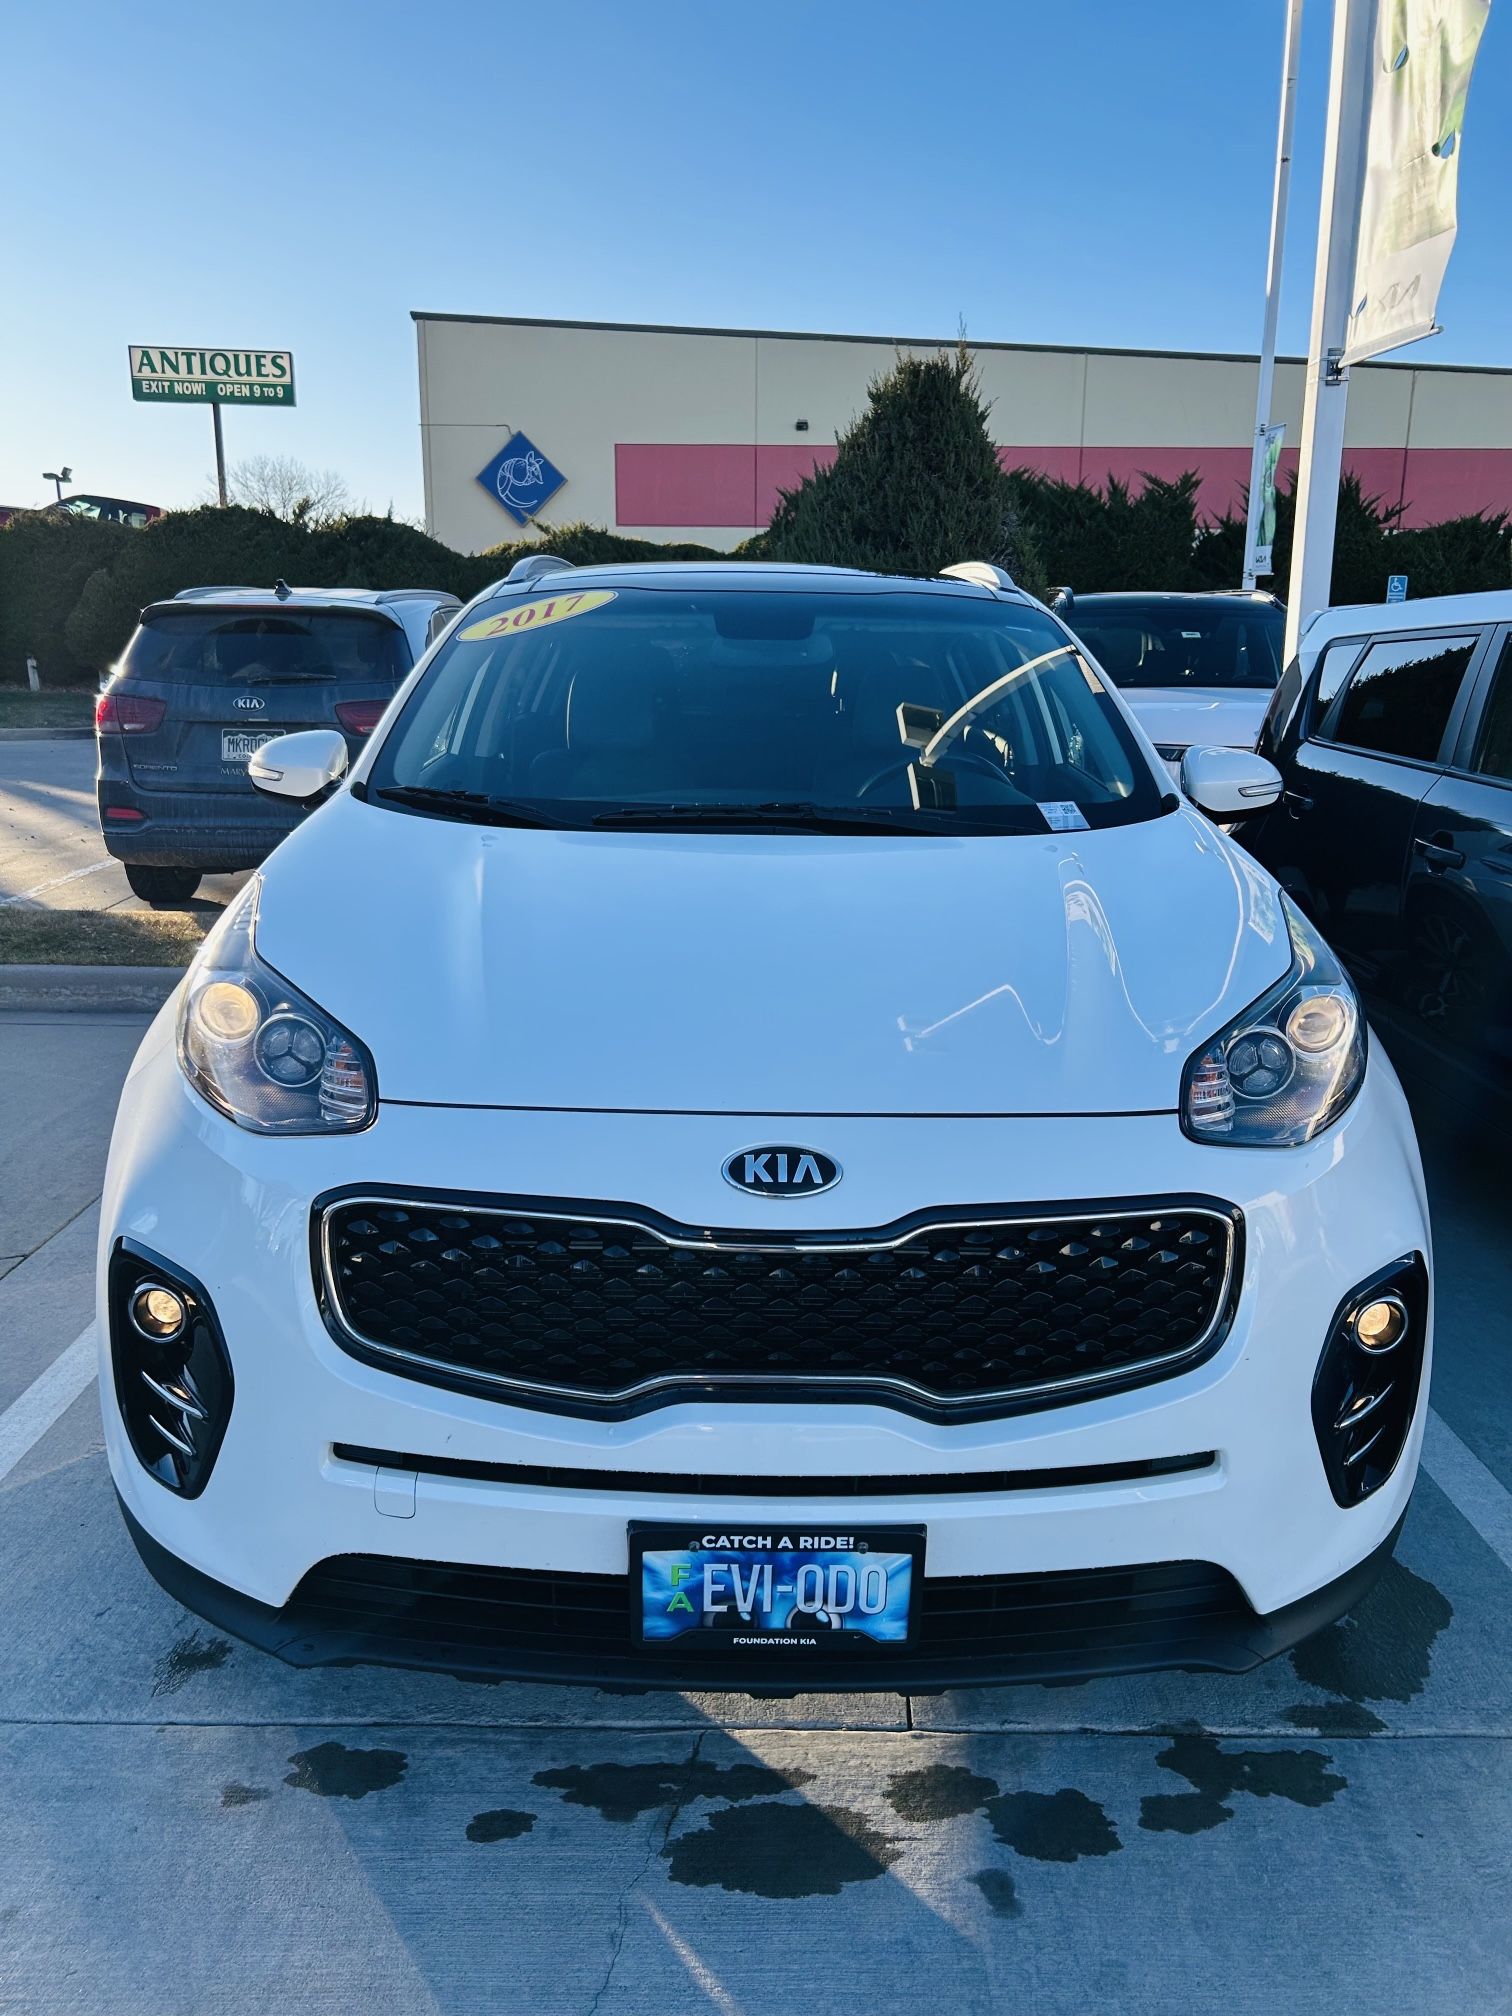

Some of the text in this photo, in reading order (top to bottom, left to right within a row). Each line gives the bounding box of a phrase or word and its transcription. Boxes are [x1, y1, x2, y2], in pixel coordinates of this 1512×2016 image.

[137, 350, 287, 379] ANTIQUES
[142, 380, 171, 394] EXIT
[174, 382, 206, 395] NOW!
[217, 384, 250, 397] OPEN
[253, 385, 261, 398] 9
[276, 386, 284, 398] 9
[486, 594, 586, 635] 2017
[237, 699, 260, 708] KIA
[744, 1153, 823, 1184] KIA
[702, 1535, 855, 1549] CATCH A RIDE!
[733, 1637, 817, 1645] FOUNDATION KIA
